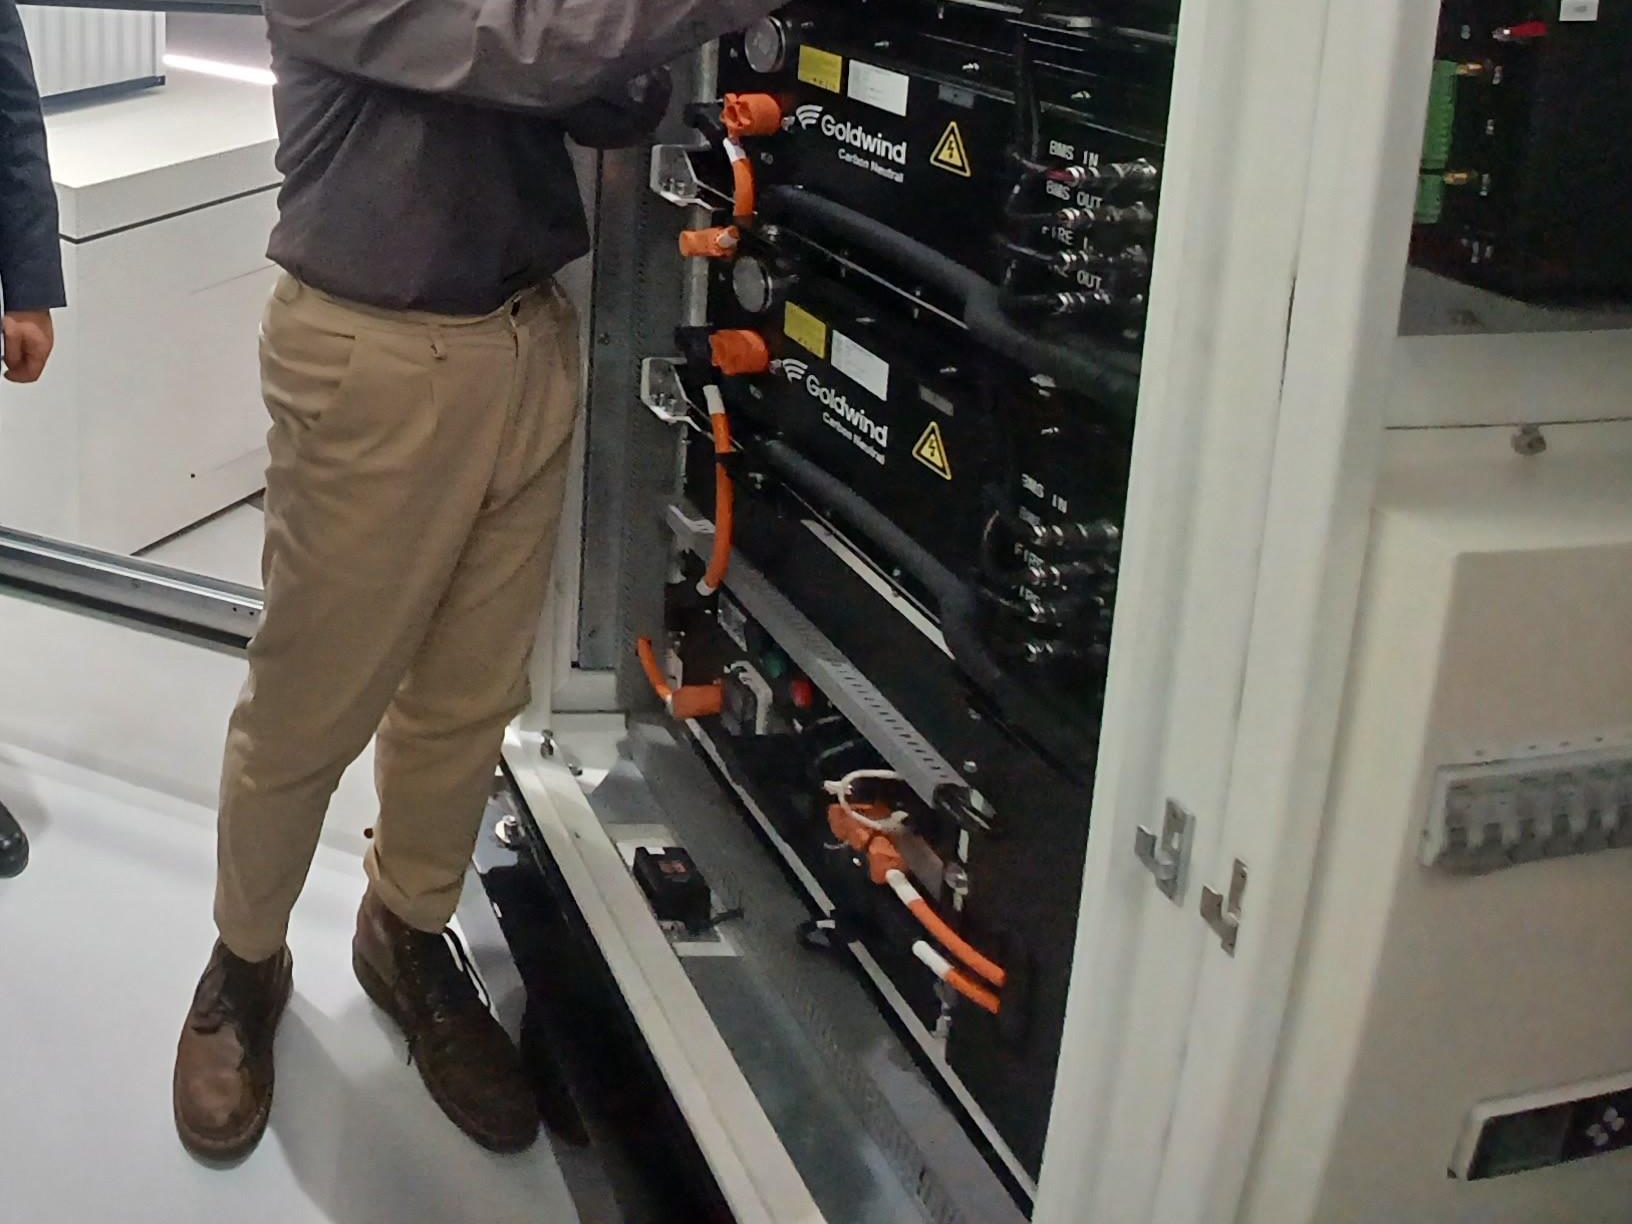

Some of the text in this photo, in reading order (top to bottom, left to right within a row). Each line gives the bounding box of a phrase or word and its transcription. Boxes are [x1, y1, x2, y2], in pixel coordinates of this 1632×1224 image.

[820, 114, 908, 166] Goldwind
[1048, 139, 1100, 167] BMS IN
[838, 148, 870, 169] Carbon
[1045, 180, 1103, 209] BMS OUT
[1076, 270, 1102, 290] OUT
[806, 374, 889, 449] Goldwind
[822, 411, 853, 441] Carbon
